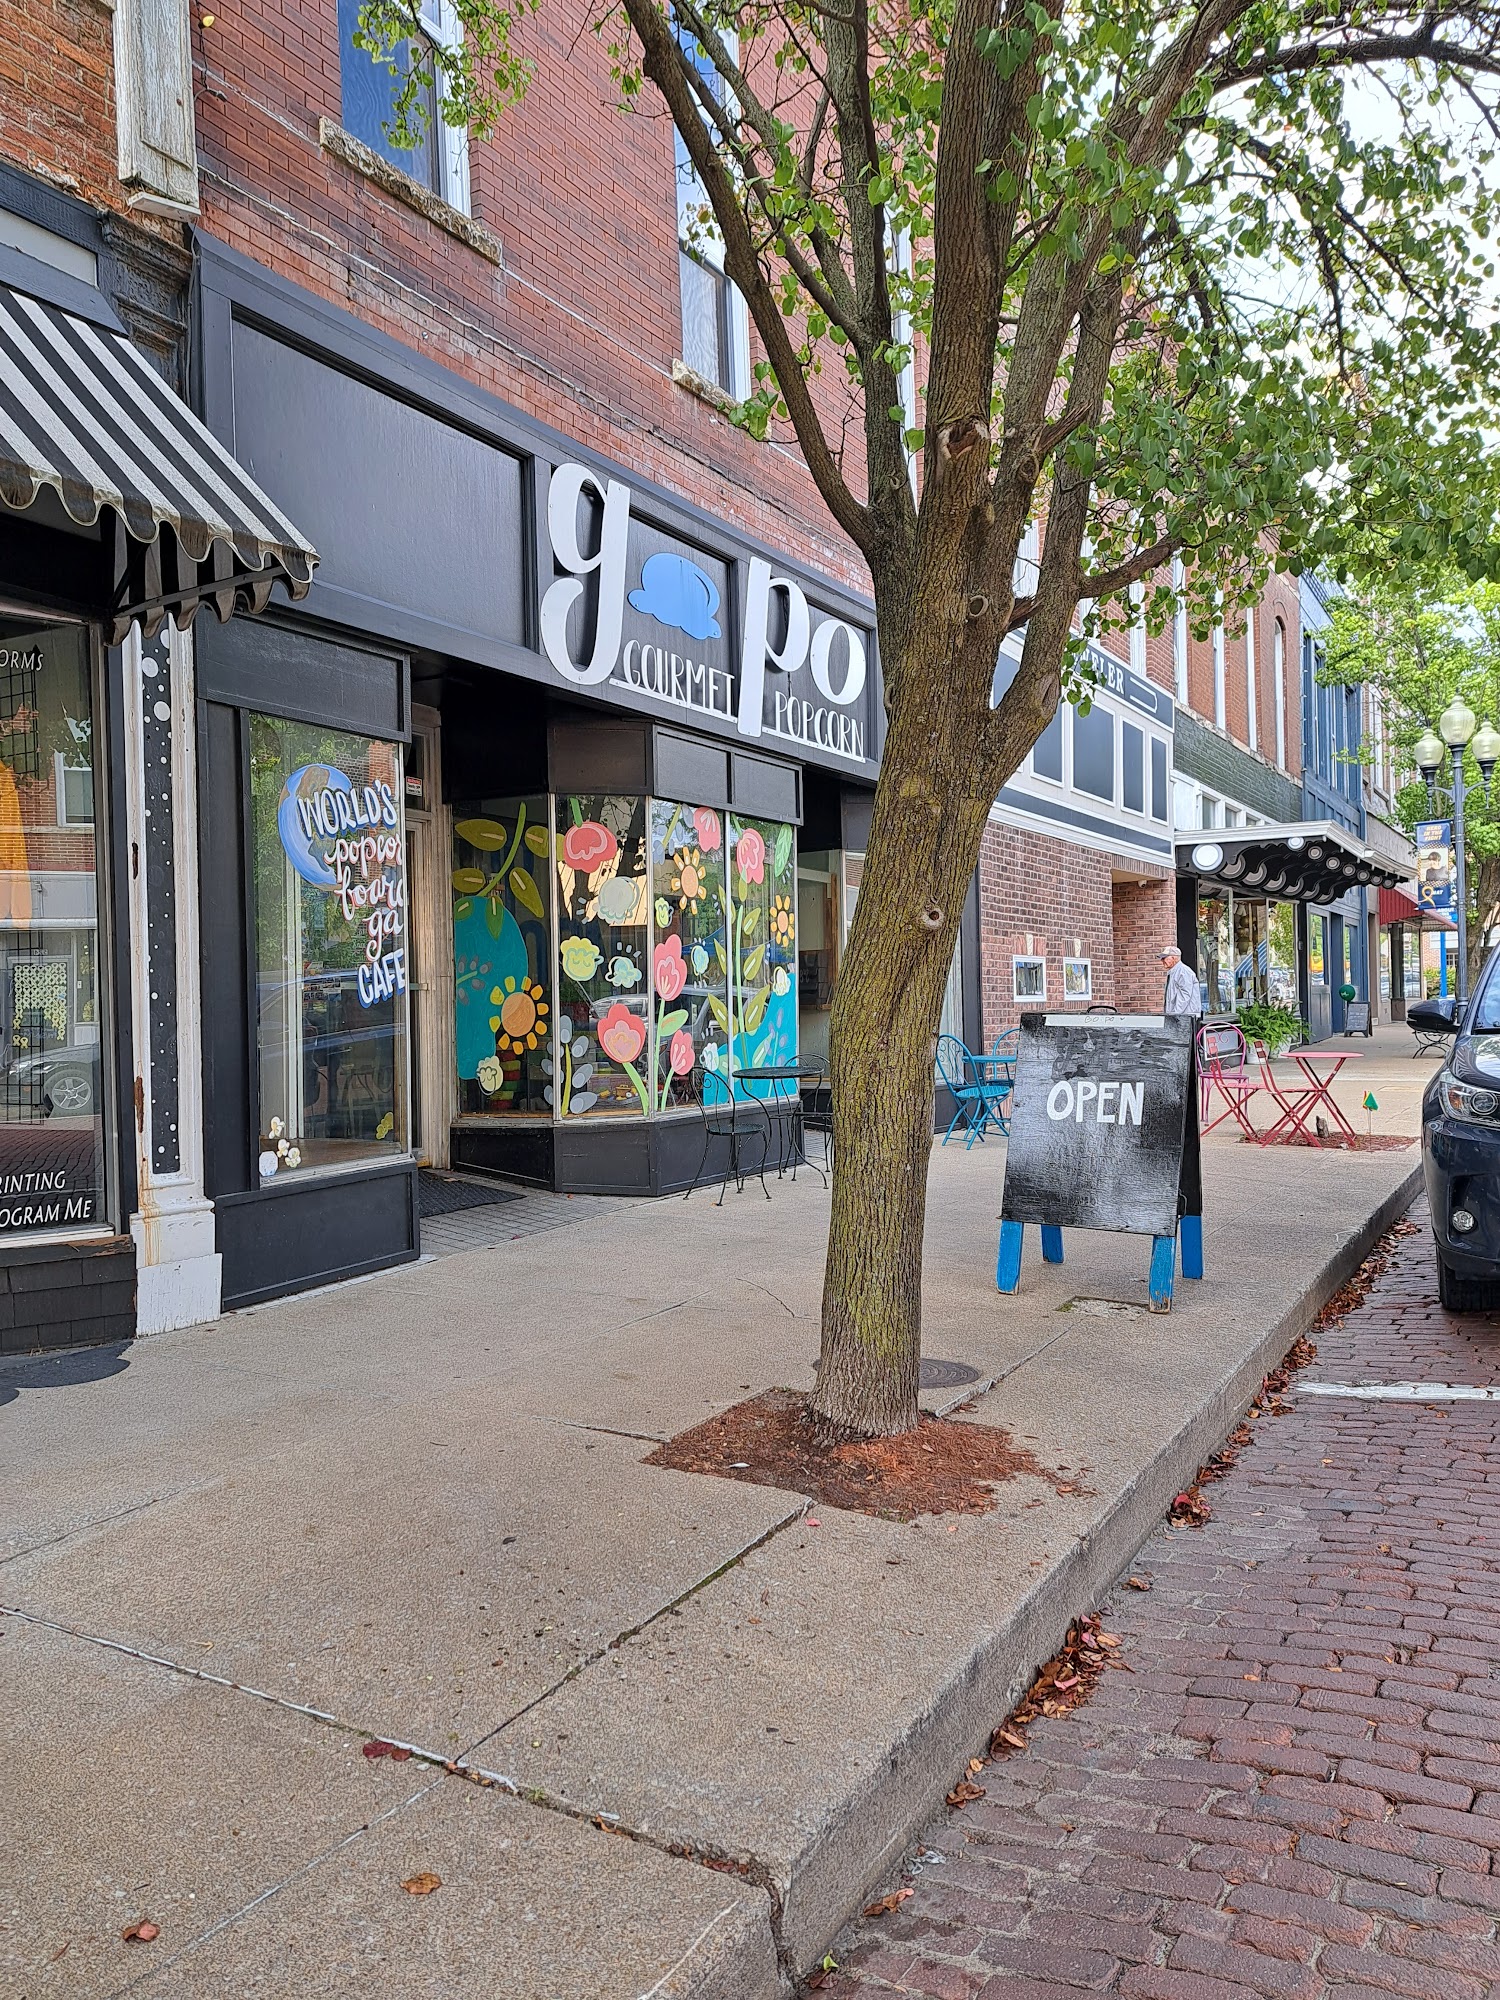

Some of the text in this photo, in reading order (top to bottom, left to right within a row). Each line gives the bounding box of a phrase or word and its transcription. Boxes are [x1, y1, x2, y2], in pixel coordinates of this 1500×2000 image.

[623, 640, 864, 759] GOURMET POPCORN
[298, 780, 398, 839] WORLD'S
[1047, 1080, 1145, 1125] OPEN
[0, 1204, 60, 1228] OGRAM
